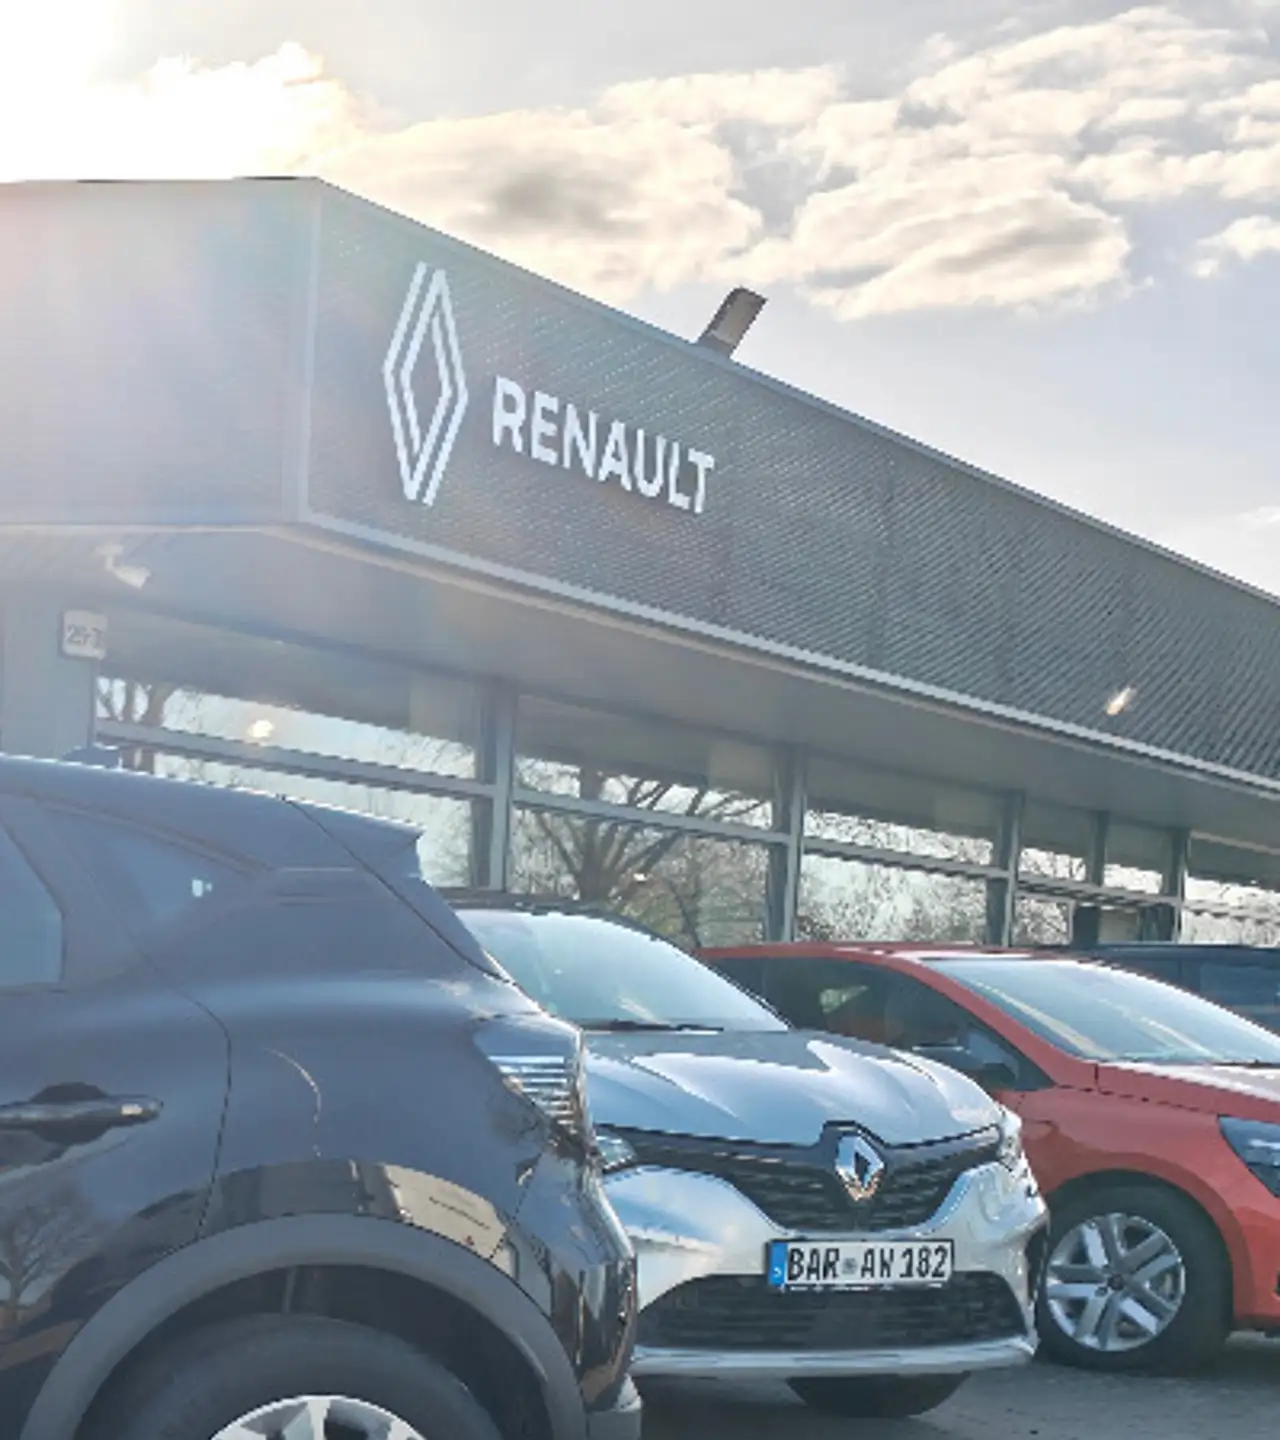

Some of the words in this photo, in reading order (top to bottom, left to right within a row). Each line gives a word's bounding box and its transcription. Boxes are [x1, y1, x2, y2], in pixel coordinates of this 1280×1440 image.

[493, 375, 715, 514] RENAULT
[787, 1247, 840, 1281] BAR
[899, 1245, 948, 1279] 182
